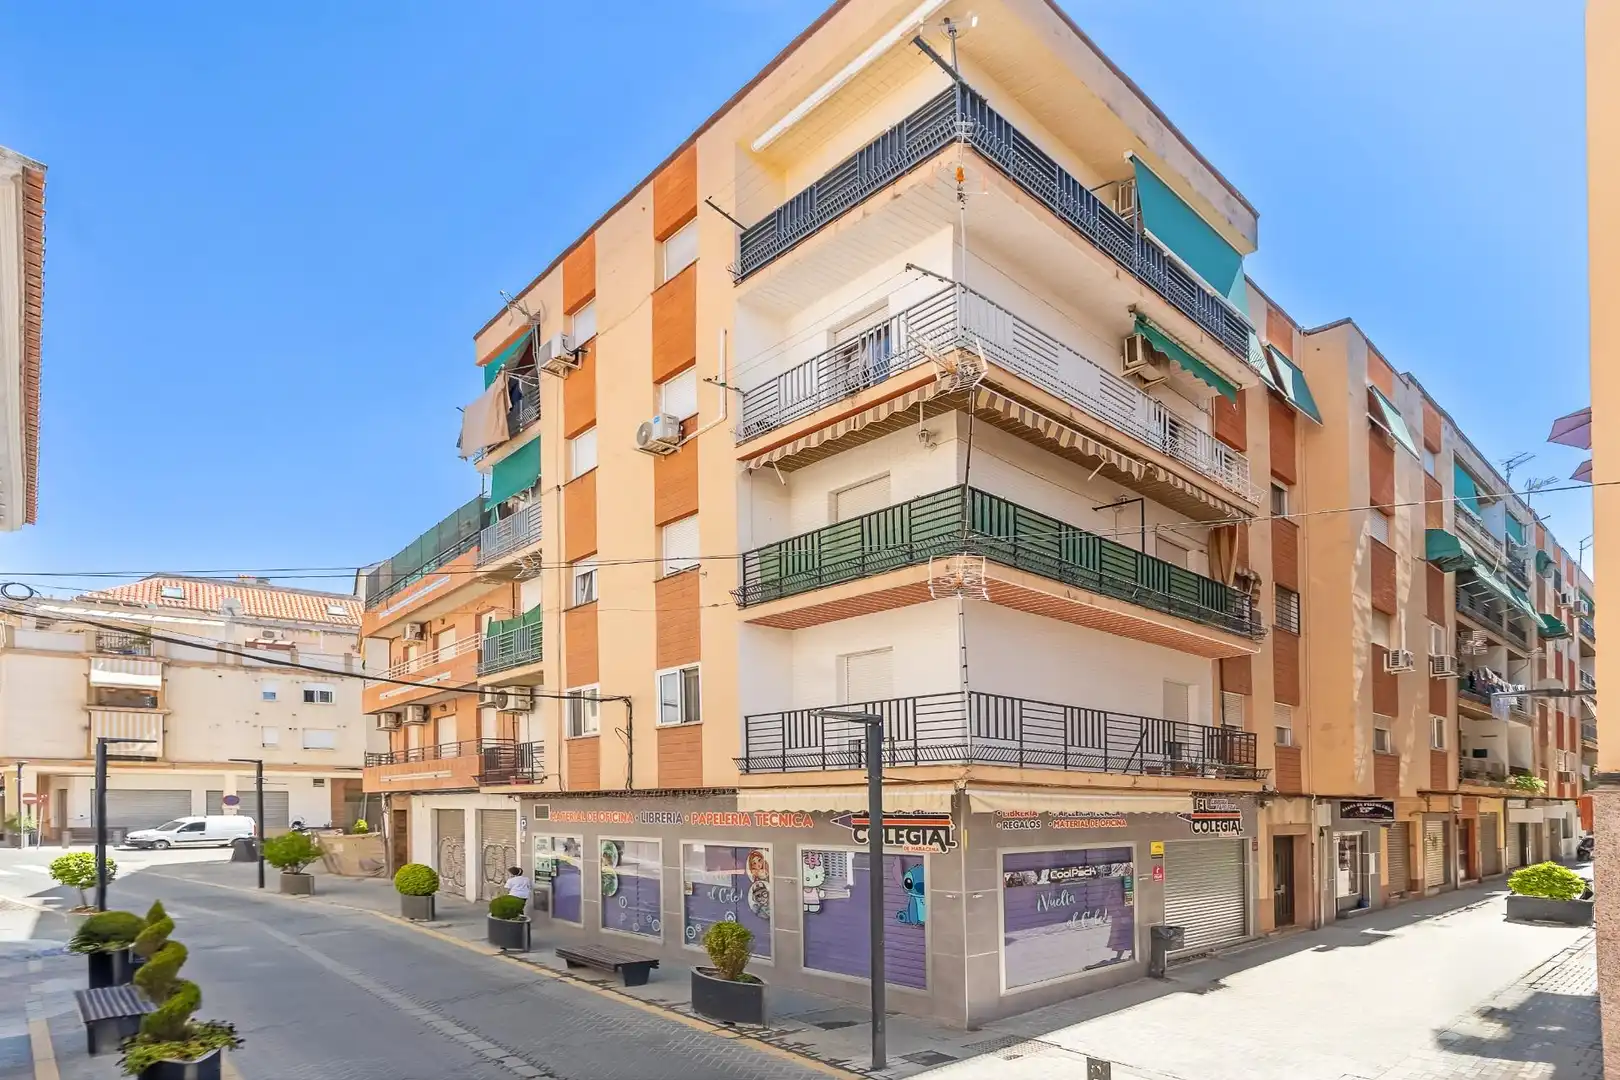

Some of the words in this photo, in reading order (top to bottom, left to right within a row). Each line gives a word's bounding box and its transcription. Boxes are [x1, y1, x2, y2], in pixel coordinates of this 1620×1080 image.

[550, 810, 586, 822] MATERIAL
[586, 811, 598, 822] DE
[599, 811, 635, 823] OFICINA
[640, 811, 684, 824] LIBRERIA
[1052, 818, 1089, 829] MATERIAL
[1090, 818, 1099, 828] DE
[1100, 818, 1127, 828] OFICINA
[1002, 819, 1041, 830] REGALOS
[1192, 820, 1243, 835] COLEGIAL
[852, 825, 957, 853] CLEGIAL
[1050, 866, 1097, 879] CoolPack
